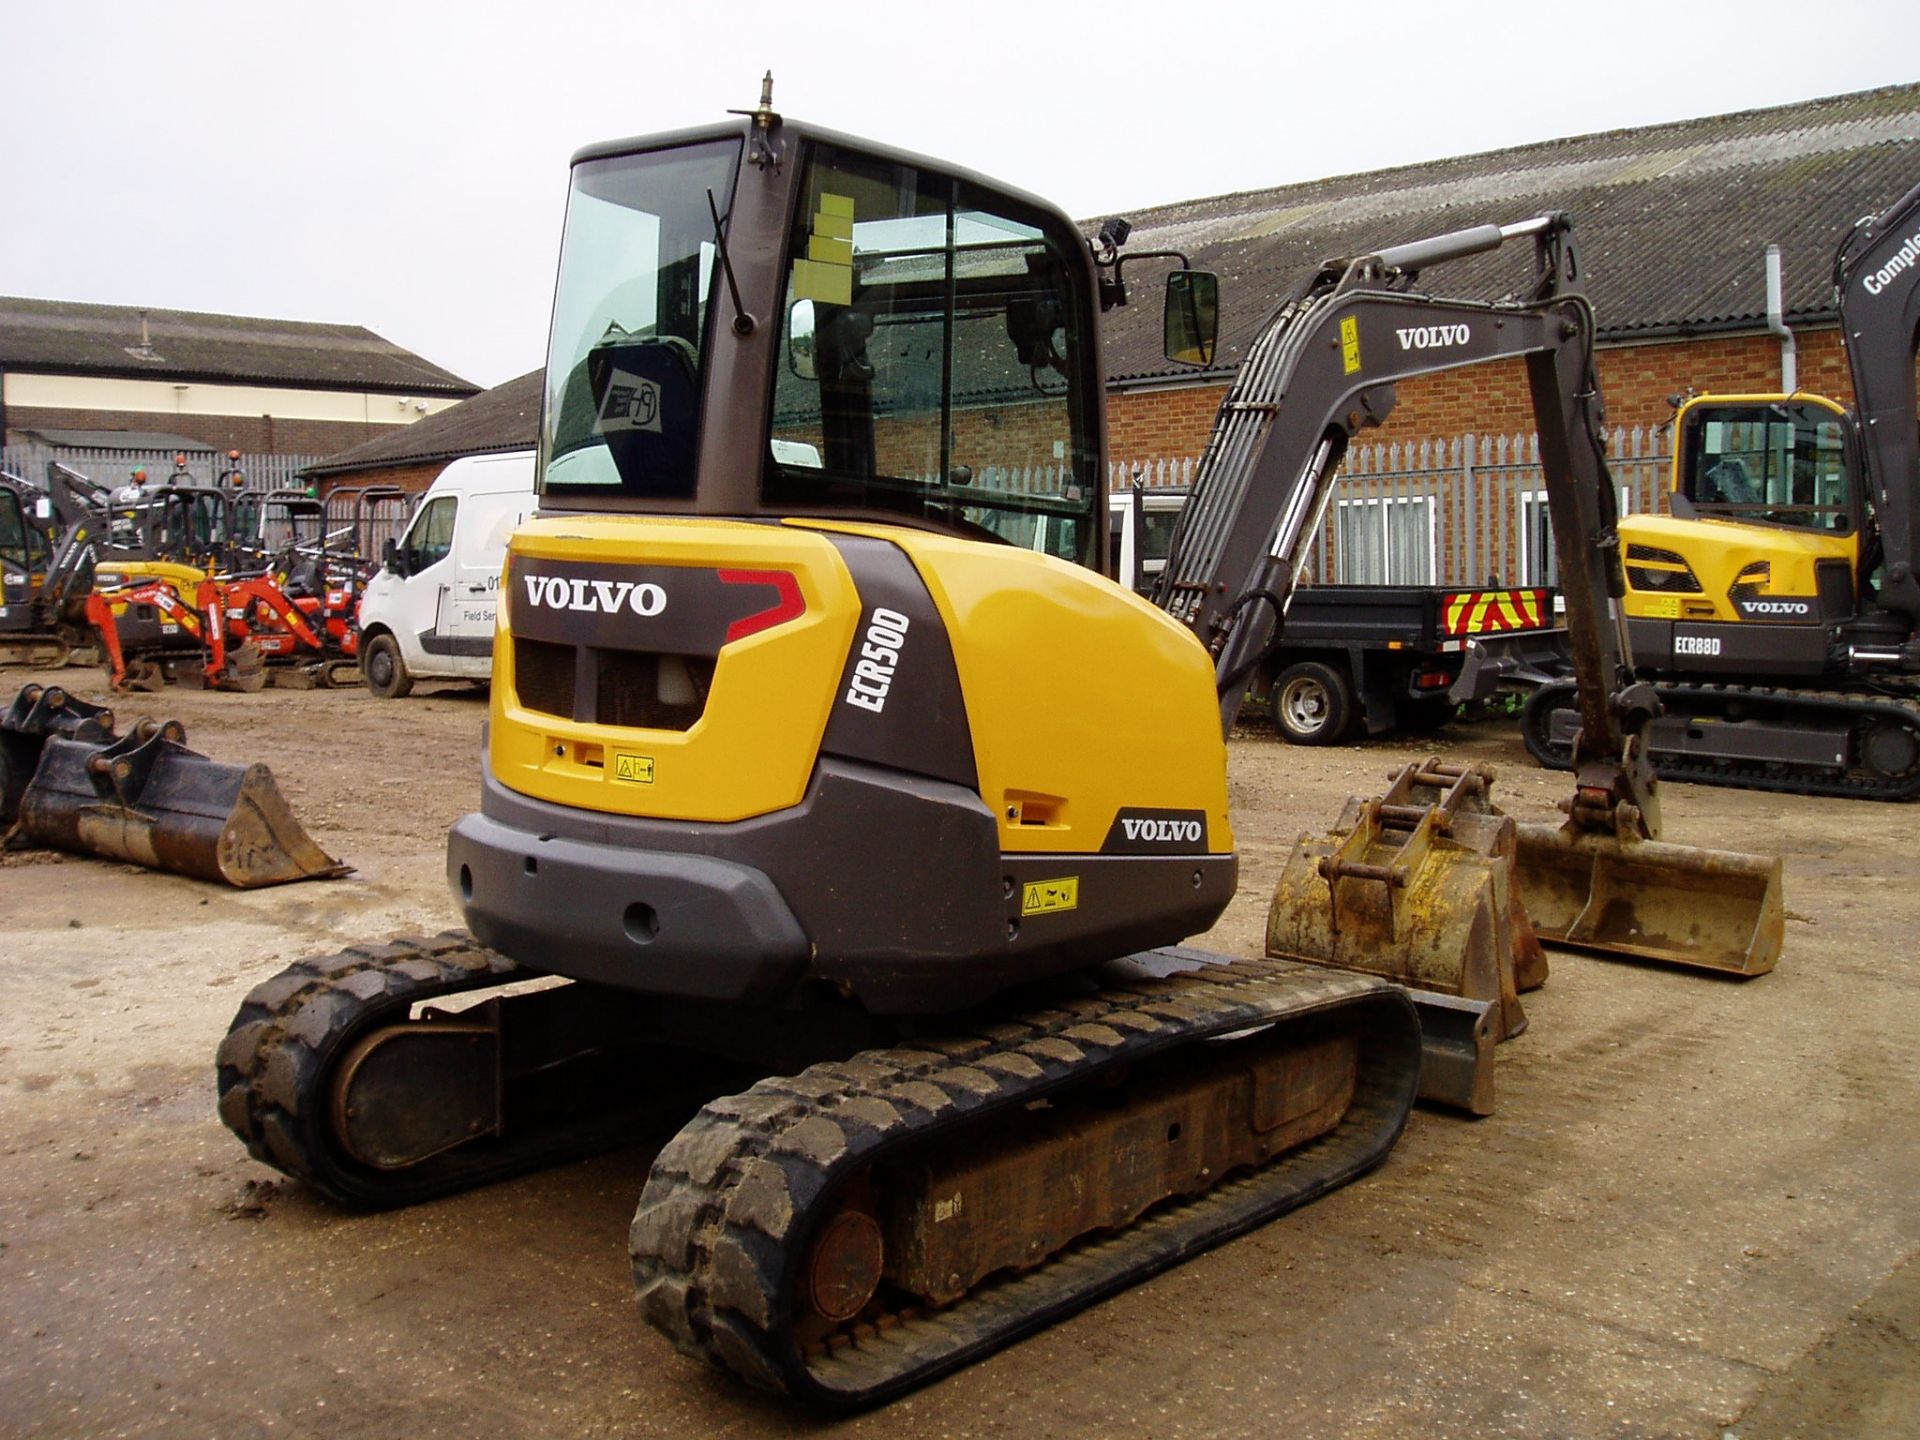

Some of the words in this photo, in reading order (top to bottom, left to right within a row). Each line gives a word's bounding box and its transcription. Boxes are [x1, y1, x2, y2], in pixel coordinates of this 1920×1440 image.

[1863, 226, 1920, 294] Comple
[1396, 324, 1470, 350] VOLVO
[488, 576, 501, 590] 01
[524, 575, 667, 616] VOLVO
[464, 610, 481, 621] Field
[1741, 601, 1808, 614] VOLVO
[1675, 636, 1721, 655] ECR88D
[846, 608, 909, 713] ECR50D
[1122, 819, 1202, 842] VOLVO
